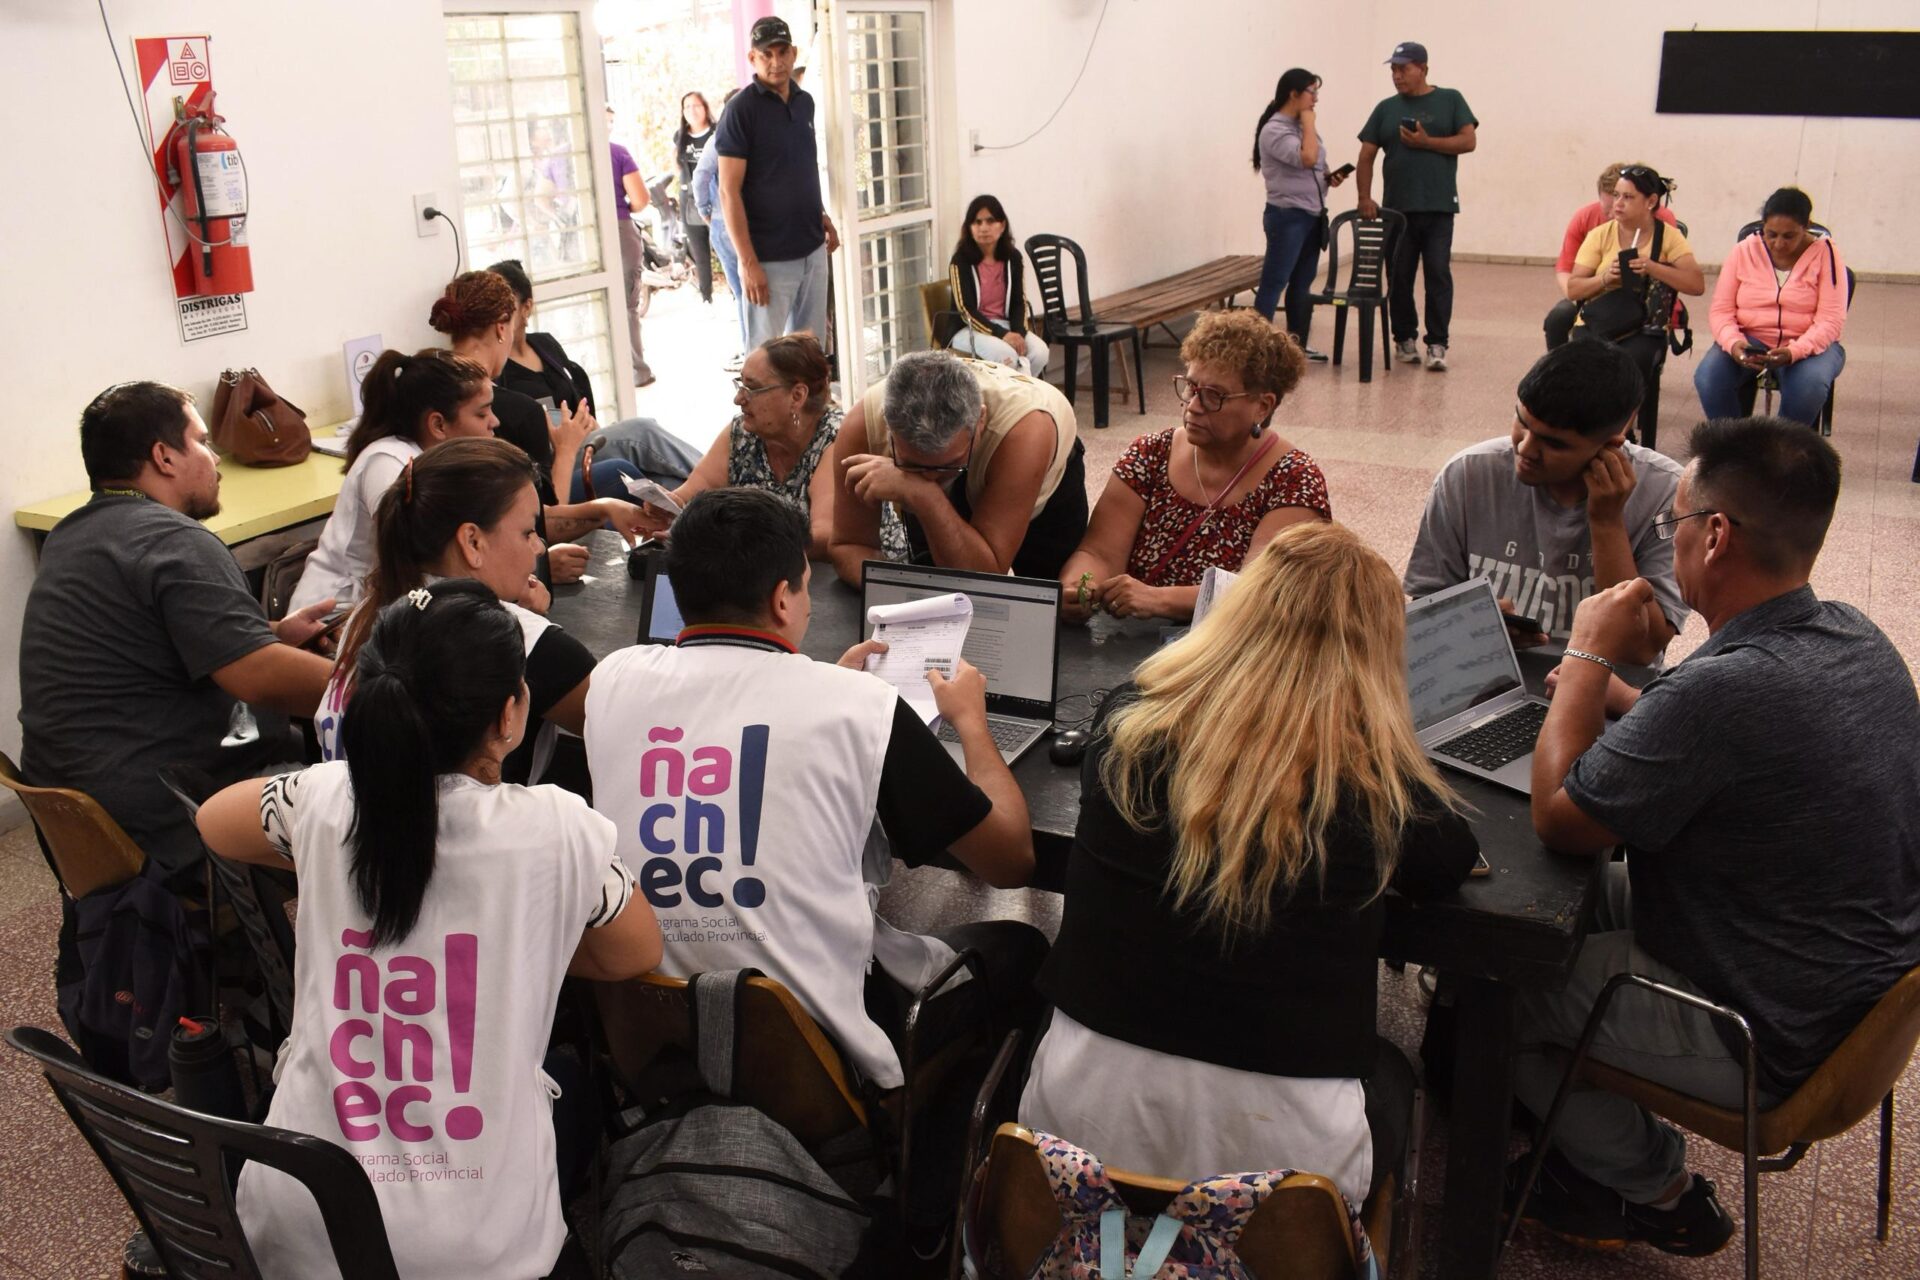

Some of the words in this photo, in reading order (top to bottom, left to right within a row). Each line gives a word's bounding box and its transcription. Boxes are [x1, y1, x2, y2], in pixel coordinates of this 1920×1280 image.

[181, 293, 241, 314] DISTRIGAS
[640, 726, 733, 798] ña
[639, 795, 725, 855] ch
[640, 856, 724, 909] ec
[663, 930, 705, 943] iculado
[707, 930, 769, 943] Provincial
[701, 915, 740, 929] Social
[333, 928, 436, 1016] ña
[329, 1012, 434, 1083] ch
[333, 1081, 434, 1143] ec
[402, 1151, 449, 1166] Social
[409, 1166, 485, 1182] Provincial
